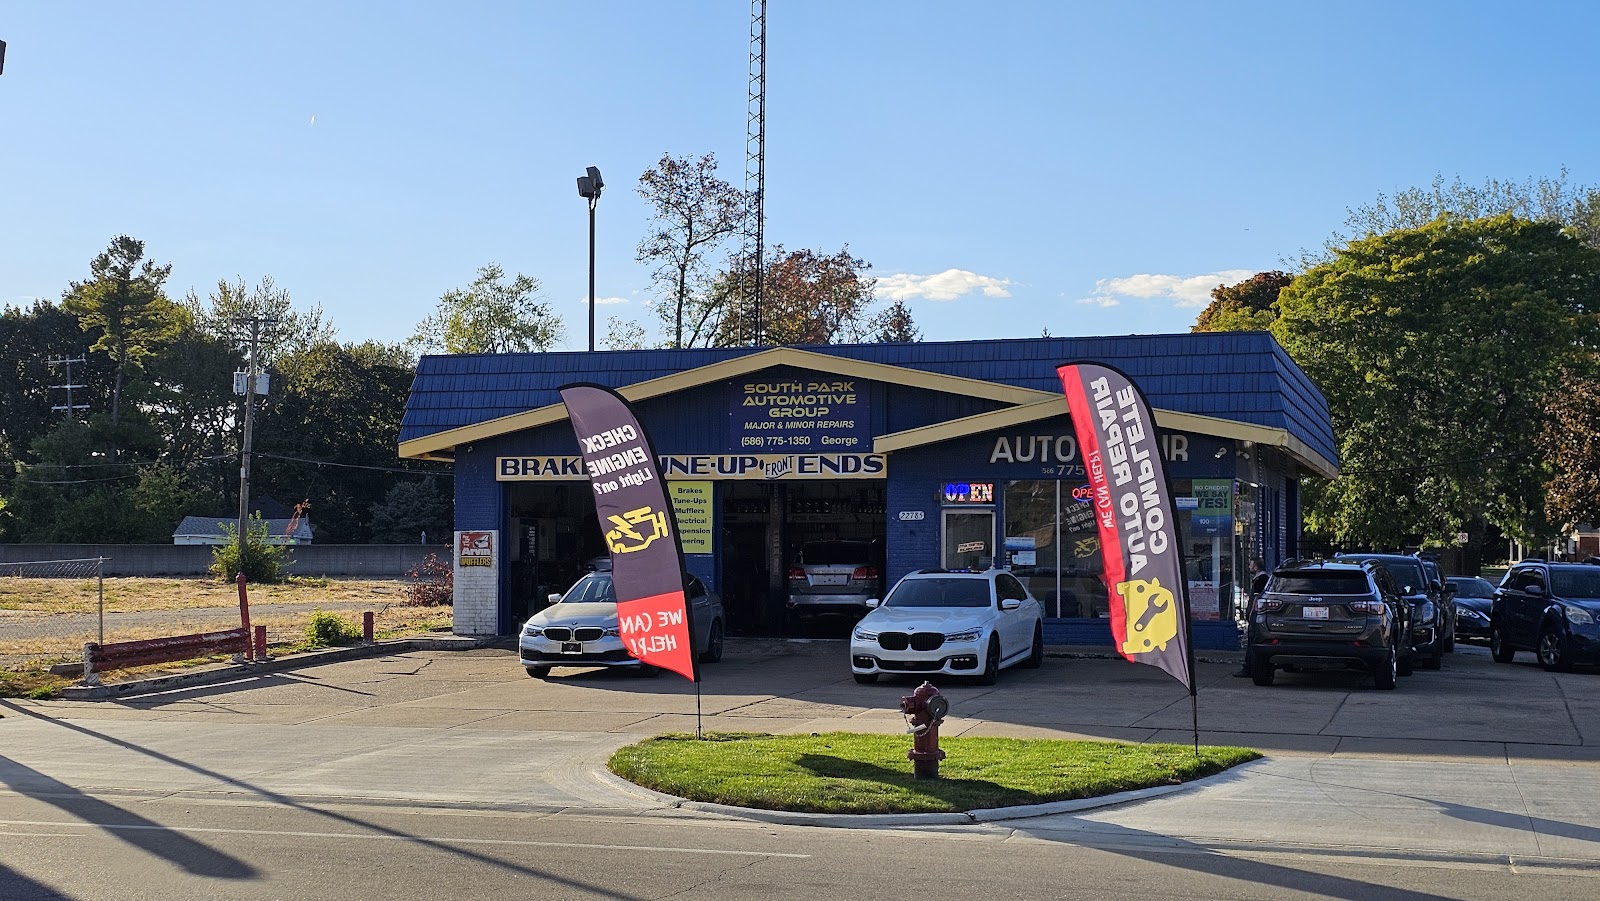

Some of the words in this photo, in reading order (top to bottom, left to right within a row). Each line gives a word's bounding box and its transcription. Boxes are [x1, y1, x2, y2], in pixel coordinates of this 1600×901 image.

[744, 383, 802, 394] SOUTH
[807, 381, 855, 392] PARK
[742, 394, 857, 406] AUTOMOTIVE
[768, 407, 830, 418] GROUP
[744, 421, 775, 430] MAJOR
[777, 421, 784, 429] &
[785, 421, 815, 429] MINOR
[816, 420, 855, 429] REPAIRS
[741, 436, 764, 447] (586)
[766, 436, 811, 446] 775-1350
[821, 435, 858, 447] George
[989, 435, 1076, 463] AUTO
[500, 457, 589, 476] BRAK
[765, 455, 794, 476] FRONT
[798, 454, 884, 474] ENDS
[1057, 464, 1085, 476] 775
[945, 483, 994, 502] OPEN
[1072, 487, 1094, 499] OPE
[1194, 490, 1209, 498] WE
[1211, 490, 1229, 498] SAY
[673, 497, 707, 505] Tune-Ups
[1198, 497, 1228, 509] YES!
[900, 512, 923, 520] 22785
[681, 537, 705, 545] eering
[461, 547, 490, 556] Arvin
[461, 557, 491, 566] MUFFLERS
